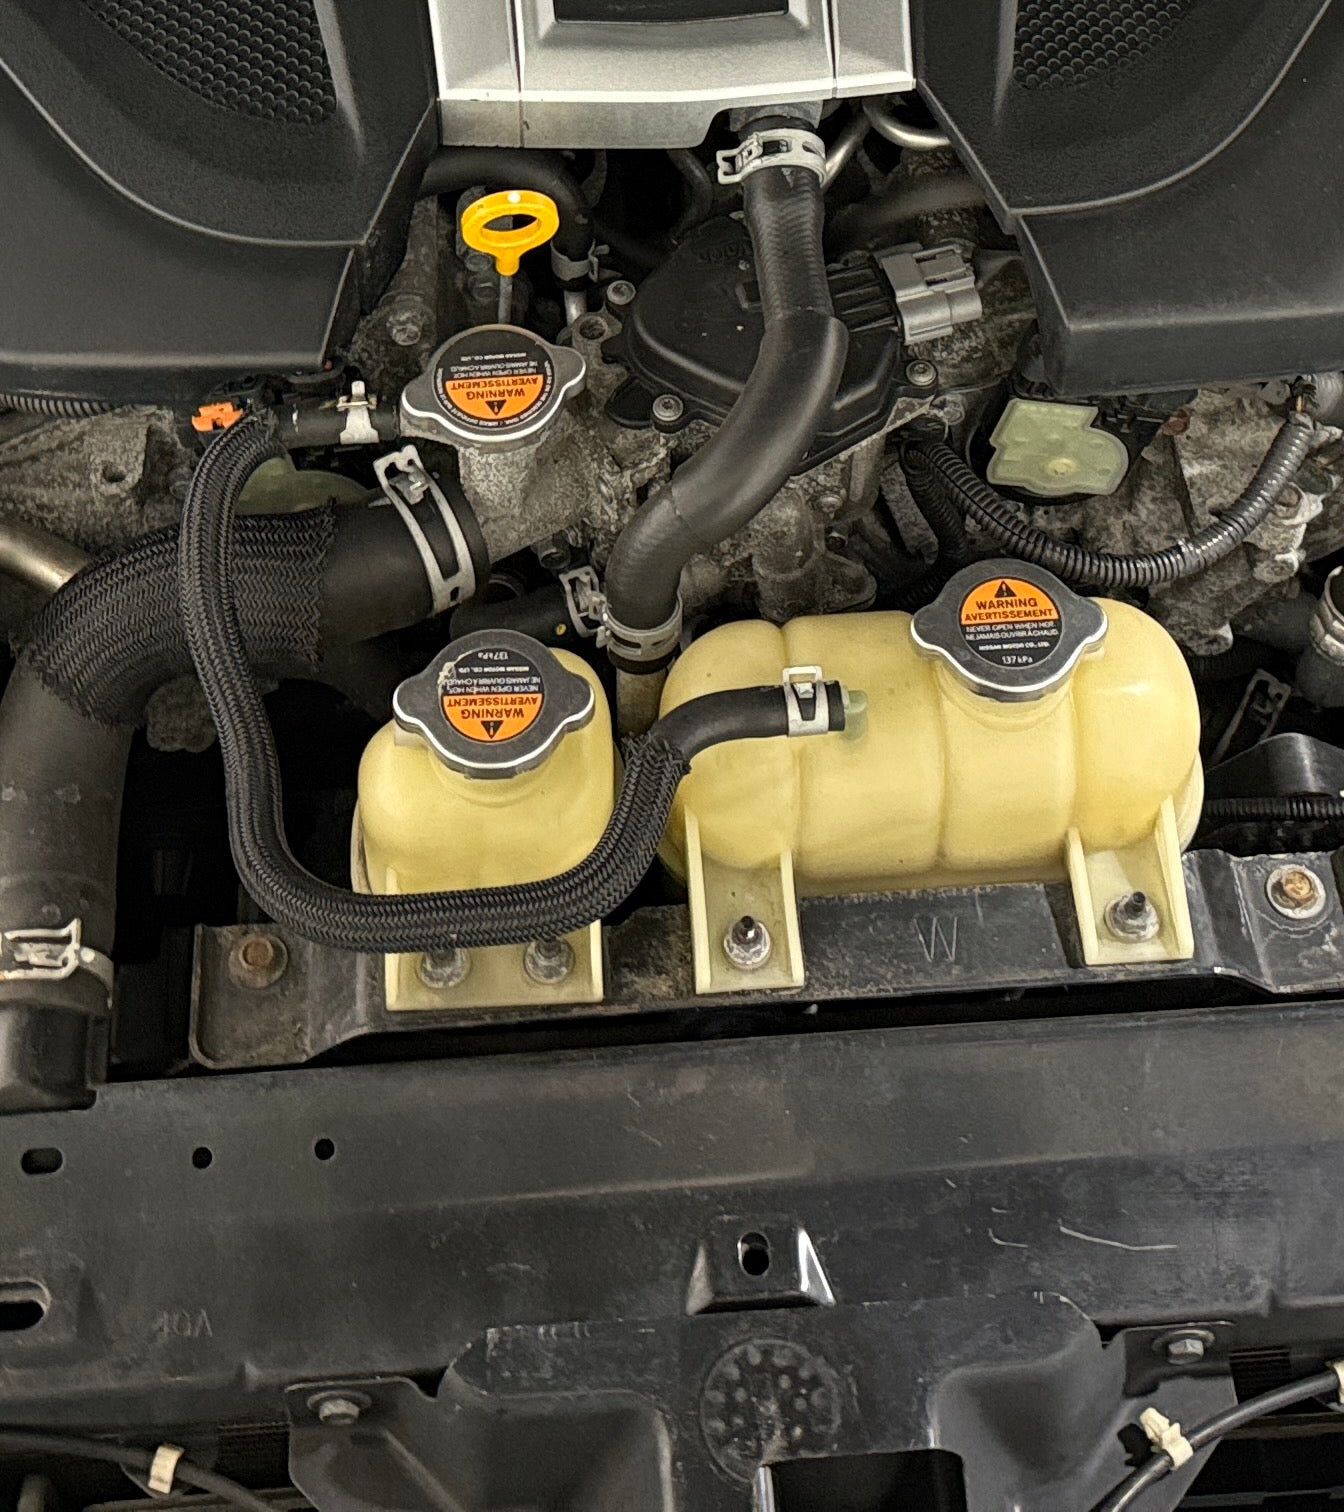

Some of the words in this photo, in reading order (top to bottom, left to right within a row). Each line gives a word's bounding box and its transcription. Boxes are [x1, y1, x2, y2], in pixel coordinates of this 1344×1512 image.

[451, 377, 538, 390] AVERTISSEMENT
[466, 388, 525, 400] WARNING
[976, 597, 1038, 610] WARNING
[965, 609, 1053, 622] AVERTISSEMENT
[966, 625, 991, 633] NEVER
[991, 623, 1013, 631] OPEN
[1014, 622, 1037, 630] WHEN
[494, 651, 508, 660] 137
[1002, 655, 1016, 664] 137
[1017, 655, 1033, 663] kPa
[447, 697, 538, 707] AVERTISSEMENT
[461, 707, 524, 719] WARNING
